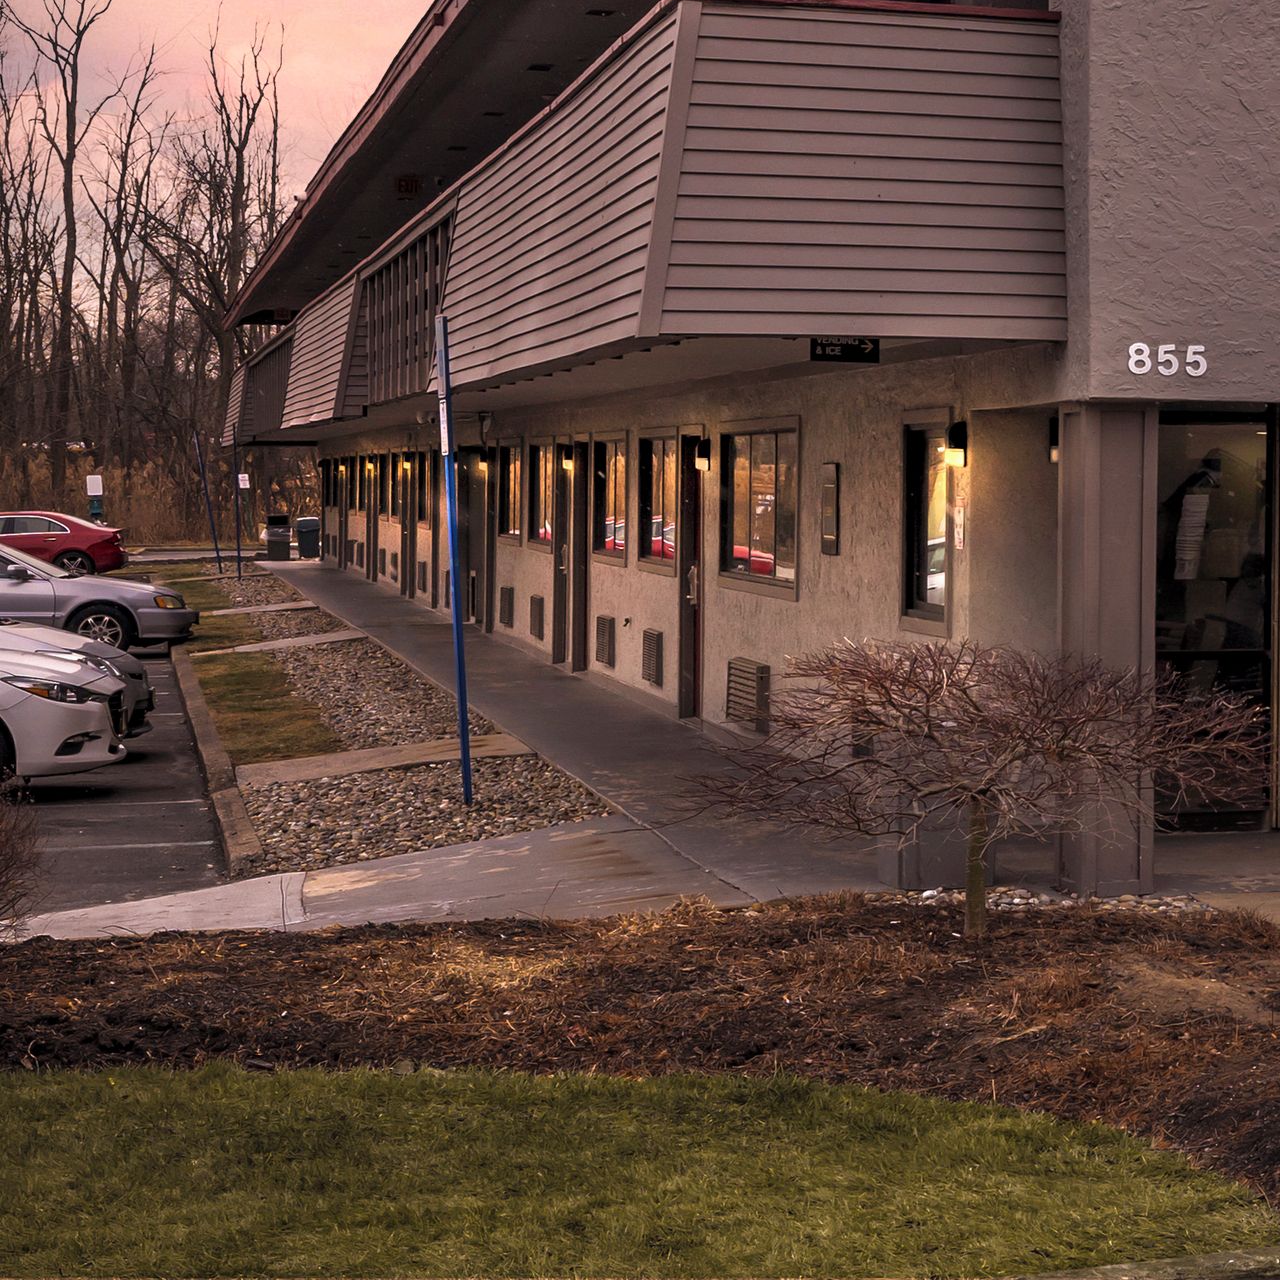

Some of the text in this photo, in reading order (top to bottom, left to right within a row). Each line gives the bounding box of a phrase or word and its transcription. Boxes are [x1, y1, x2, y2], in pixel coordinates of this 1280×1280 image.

[816, 336, 859, 345] VENDING
[816, 346, 842, 355] & ICE
[1127, 342, 1208, 377] 855
